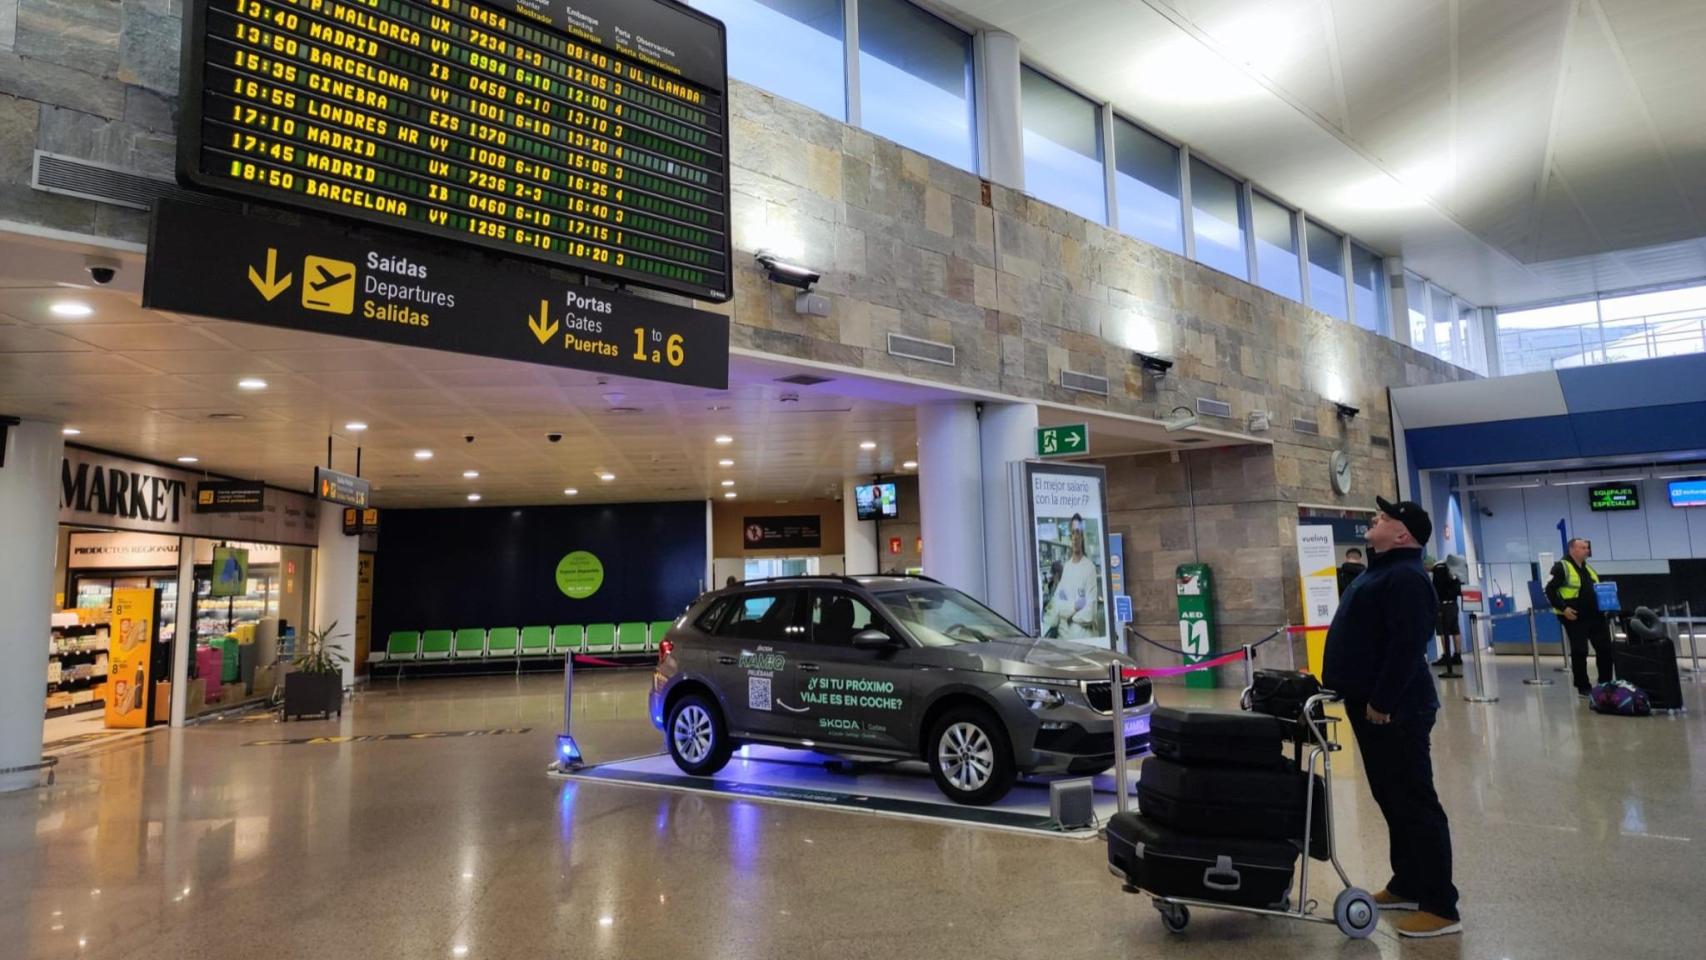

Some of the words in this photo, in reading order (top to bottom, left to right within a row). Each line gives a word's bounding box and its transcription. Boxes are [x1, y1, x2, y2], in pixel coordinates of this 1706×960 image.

[470, 7, 506, 30] 0454
[567, 43, 606, 68] 08:40
[615, 62, 621, 74] 3
[237, 0, 298, 30] 13:40
[310, 22, 378, 57] MADRID
[430, 62, 449, 80] IB
[470, 76, 506, 100] 0458
[515, 91, 550, 113] 6-10
[568, 110, 607, 133] 13:10
[615, 126, 622, 138] 3
[311, 0, 420, 46] P.MALLORCA
[432, 39, 450, 56] VY
[470, 53, 506, 75] 8994
[515, 69, 550, 91] 6-10
[568, 87, 607, 111] 12:00
[615, 105, 622, 116] 4
[431, 15, 450, 33] UX
[470, 30, 506, 54] 7234
[516, 47, 542, 67] 2-3
[567, 67, 607, 90] 12:05
[615, 83, 621, 95] 3
[236, 24, 297, 55] 13:50
[310, 48, 409, 91] BARCELONA
[431, 86, 449, 104] VY
[470, 99, 505, 122] 1001
[515, 114, 550, 136] 6-10
[568, 131, 607, 154] 13:20
[615, 147, 622, 158] 4
[235, 50, 296, 82] 15:35
[309, 73, 388, 110] GINEBRA
[430, 110, 460, 131] EZS
[470, 122, 506, 145] 1370
[568, 153, 608, 175] 15:05
[615, 168, 623, 180] 3
[234, 78, 296, 109] 16:55
[308, 99, 388, 135] LONDRES
[397, 126, 419, 144] HR
[430, 135, 449, 152] VY
[470, 147, 506, 168] 1008
[515, 160, 550, 181] 6-10
[568, 175, 608, 197] 16:25
[616, 189, 623, 201] 4
[233, 105, 295, 135] 17:10
[307, 126, 376, 157] MADRID
[429, 159, 449, 176] UX
[469, 170, 506, 192] 7236
[516, 183, 542, 201] 2-3
[568, 197, 608, 219] 16:40
[616, 210, 623, 223] 3
[232, 133, 294, 162] 17:45
[307, 152, 376, 183] MADRID
[429, 184, 448, 200] IB
[469, 194, 506, 216] 0460
[515, 206, 550, 227] 6-10
[568, 219, 608, 241] 17:15
[616, 232, 623, 244] 1
[231, 160, 293, 189] 18:50
[306, 179, 407, 216] BARCELONA
[429, 209, 448, 225] VY
[469, 218, 506, 239] 1295
[515, 229, 551, 250] 6-10
[568, 242, 609, 263] 18:20
[616, 253, 624, 266] 3
[366, 251, 428, 279] Saídas
[364, 275, 455, 309] Departures
[566, 291, 612, 314] Portas
[363, 300, 430, 327] Salidas
[565, 312, 603, 333] Gates
[564, 333, 619, 357] Puertas
[633, 327, 647, 361] 1
[651, 328, 662, 343] to
[666, 333, 684, 367] 6
[651, 348, 661, 363] a
[60, 458, 186, 523] MARKET
[1035, 477, 1042, 490] El
[1043, 480, 1065, 493] mejor
[1066, 480, 1089, 493] salario
[1593, 488, 1633, 497] EQUIPAJES
[1035, 494, 1050, 505] con
[1051, 492, 1058, 505] la
[1060, 494, 1081, 509] mejor
[1593, 499, 1637, 508] ESPECIALES
[74, 545, 131, 555] PRODUCTOS
[1302, 533, 1328, 544] vueling
[807, 677, 819, 690] ¿Y
[820, 677, 829, 689] SI
[830, 678, 844, 690] TU
[846, 678, 894, 693] PRÓXIMO
[800, 691, 828, 704] VIAJE
[829, 694, 842, 705] ES
[844, 694, 858, 706] EN
[859, 696, 903, 710] COCHE?
